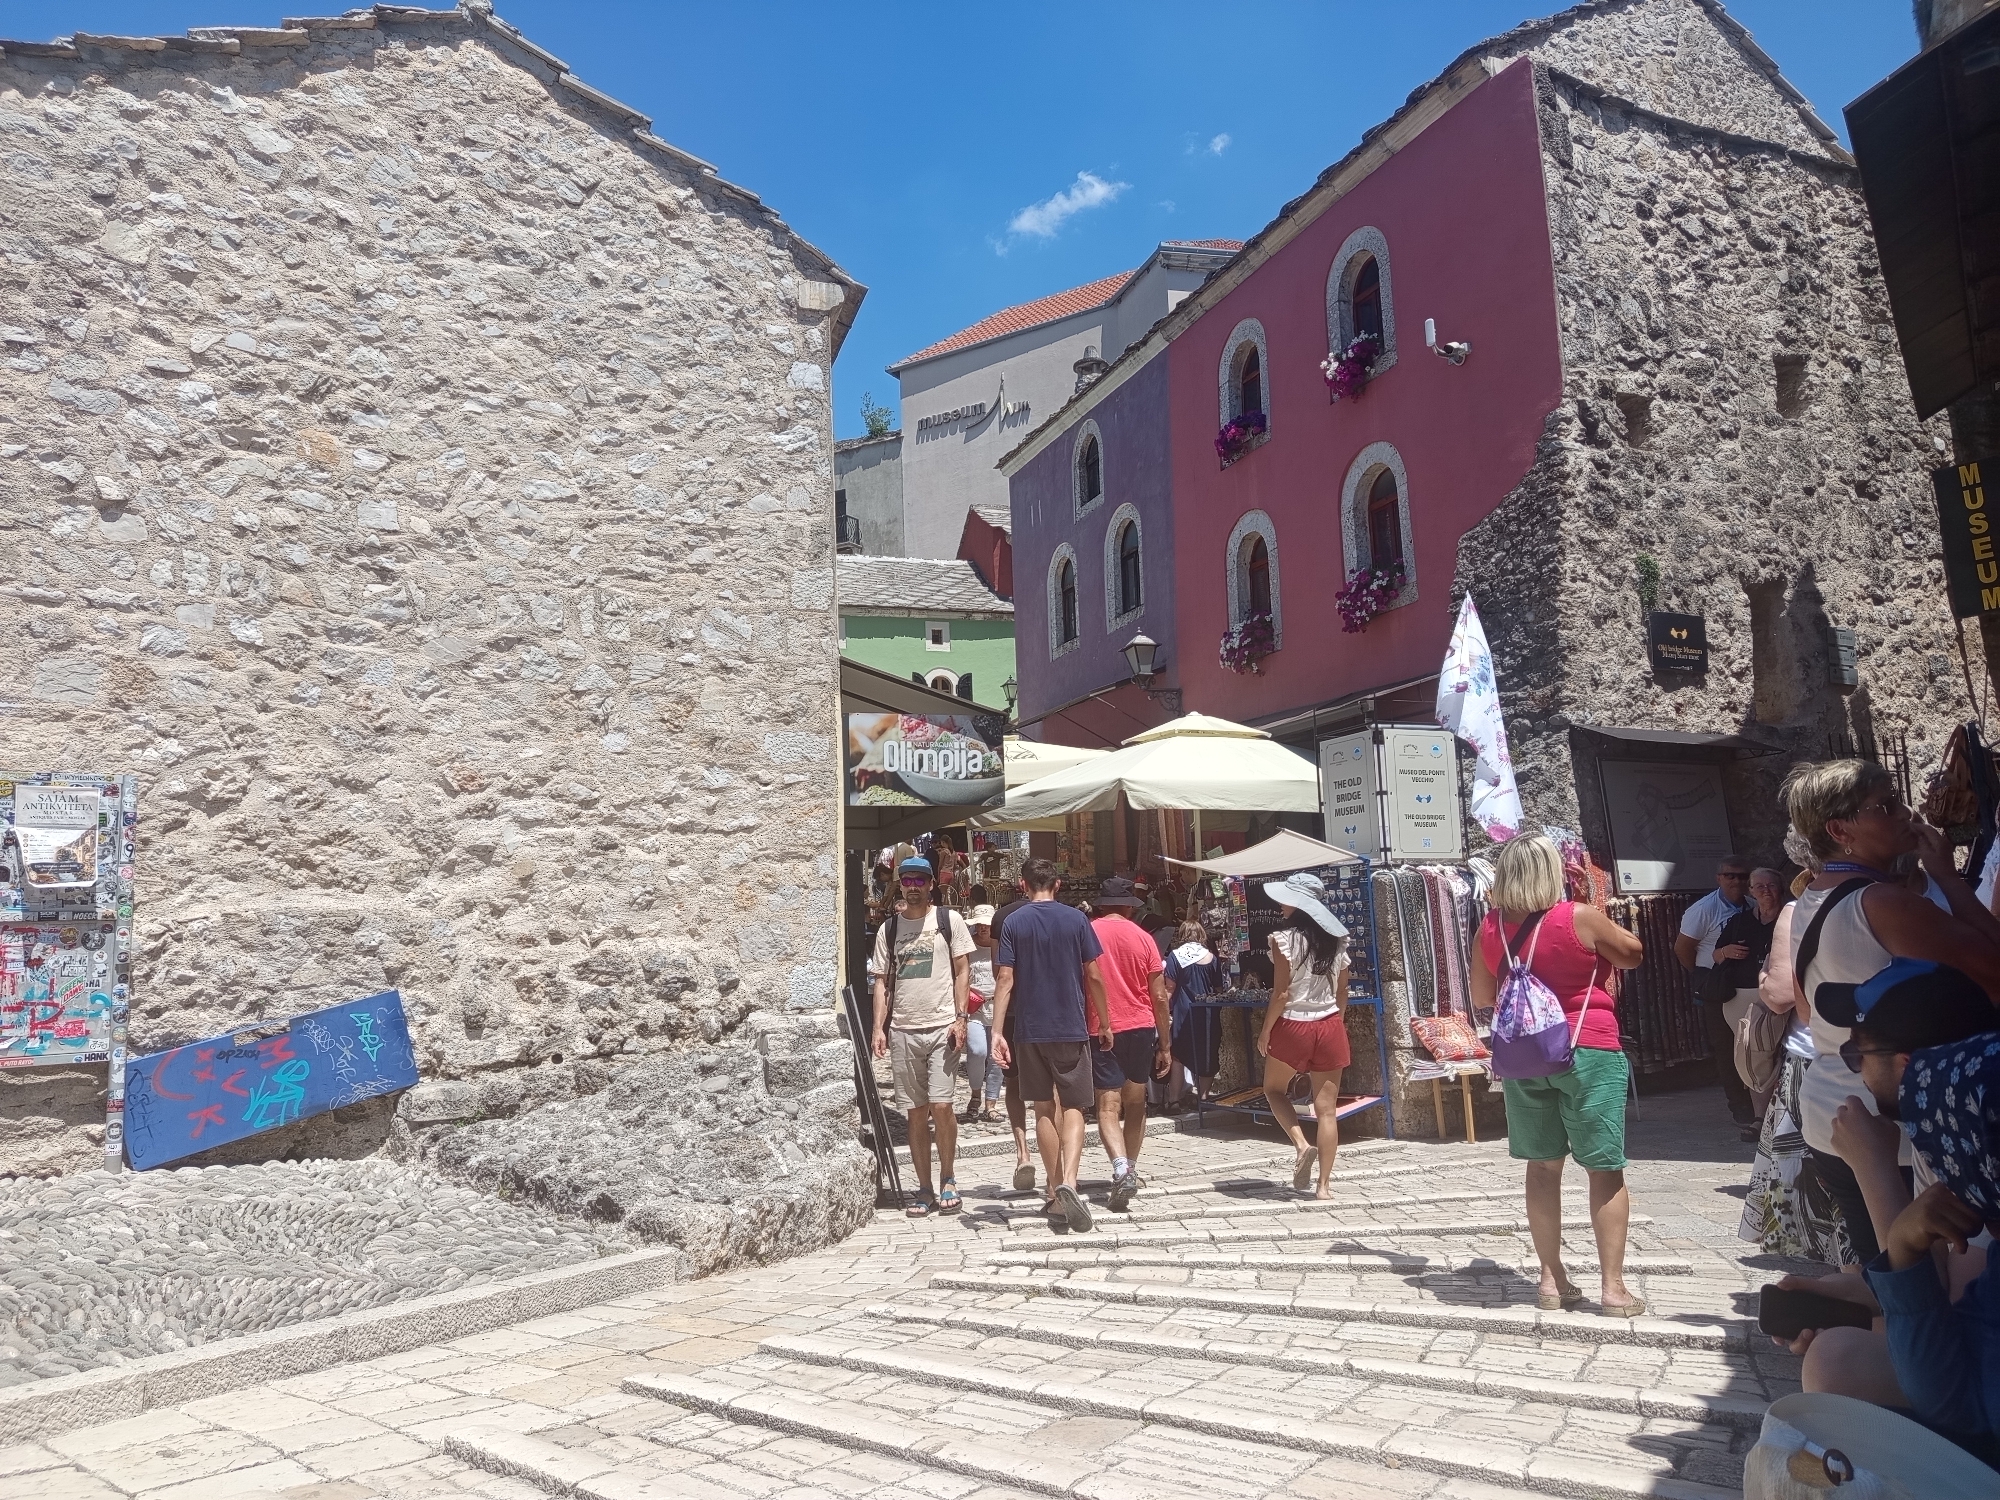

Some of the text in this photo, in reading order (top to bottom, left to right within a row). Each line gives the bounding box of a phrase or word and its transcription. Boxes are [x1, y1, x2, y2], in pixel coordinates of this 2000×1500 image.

[917, 402, 986, 431] museum
[1958, 462, 2000, 611] MUSEUM
[884, 740, 983, 780] Olimpija
[1333, 776, 1362, 790] THE OLD
[38, 794, 79, 803] SAJAM
[1336, 790, 1362, 803] BRIDGE
[22, 803, 93, 811] ANTIKVITETA
[1334, 804, 1365, 817] MUSEUM
[84, 1053, 109, 1062] HANK
